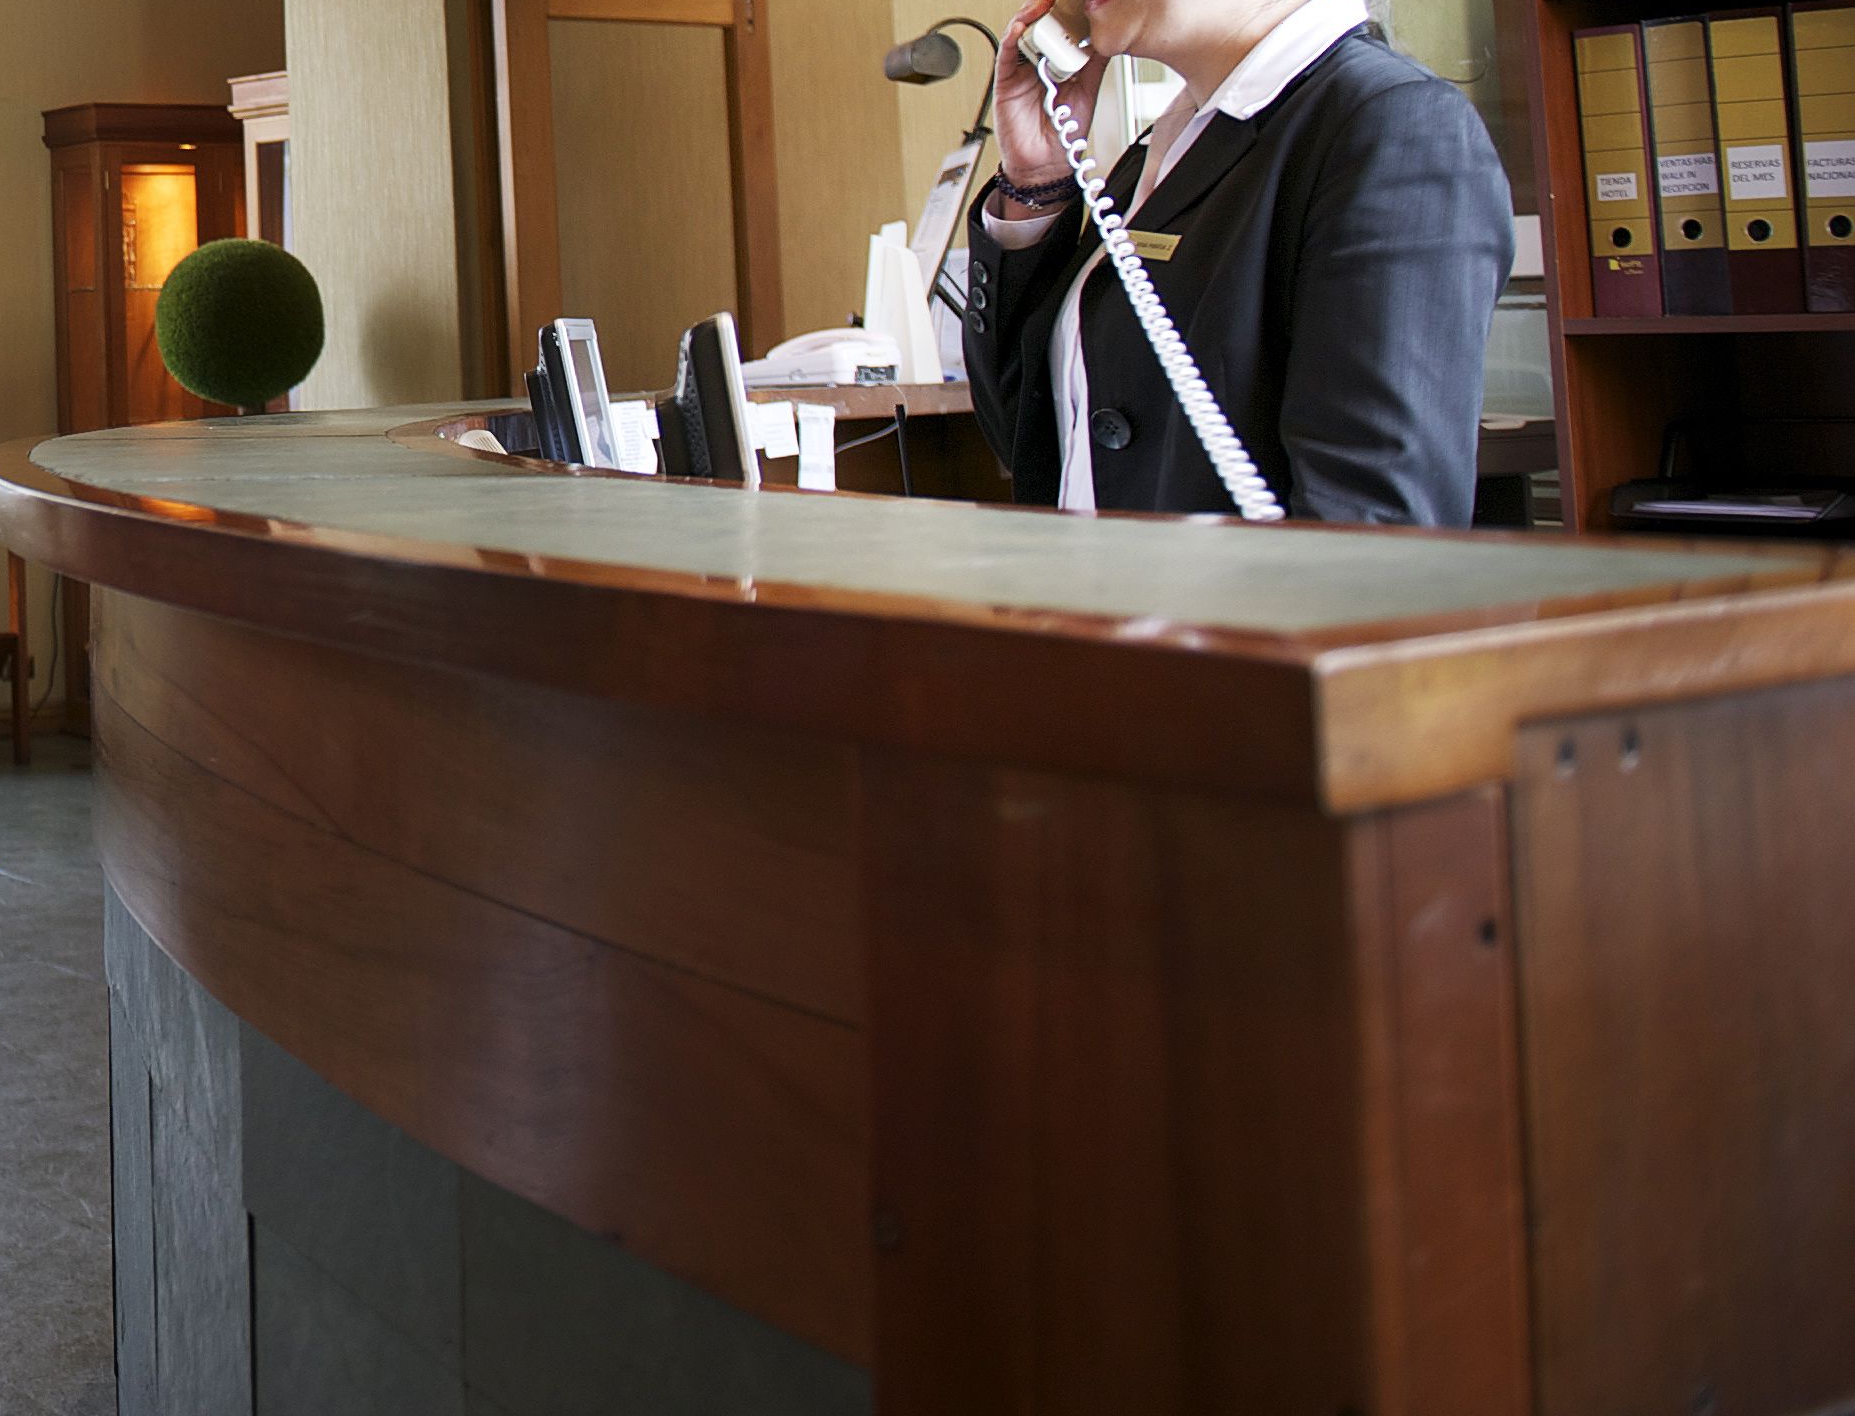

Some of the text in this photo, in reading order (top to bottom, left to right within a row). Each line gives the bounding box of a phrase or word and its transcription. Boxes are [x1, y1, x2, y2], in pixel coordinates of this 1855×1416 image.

[1731, 159, 1781, 169] RESERVAS
[1732, 172, 1775, 183] DEL MES
[1808, 171, 1855, 180] NACIONA
